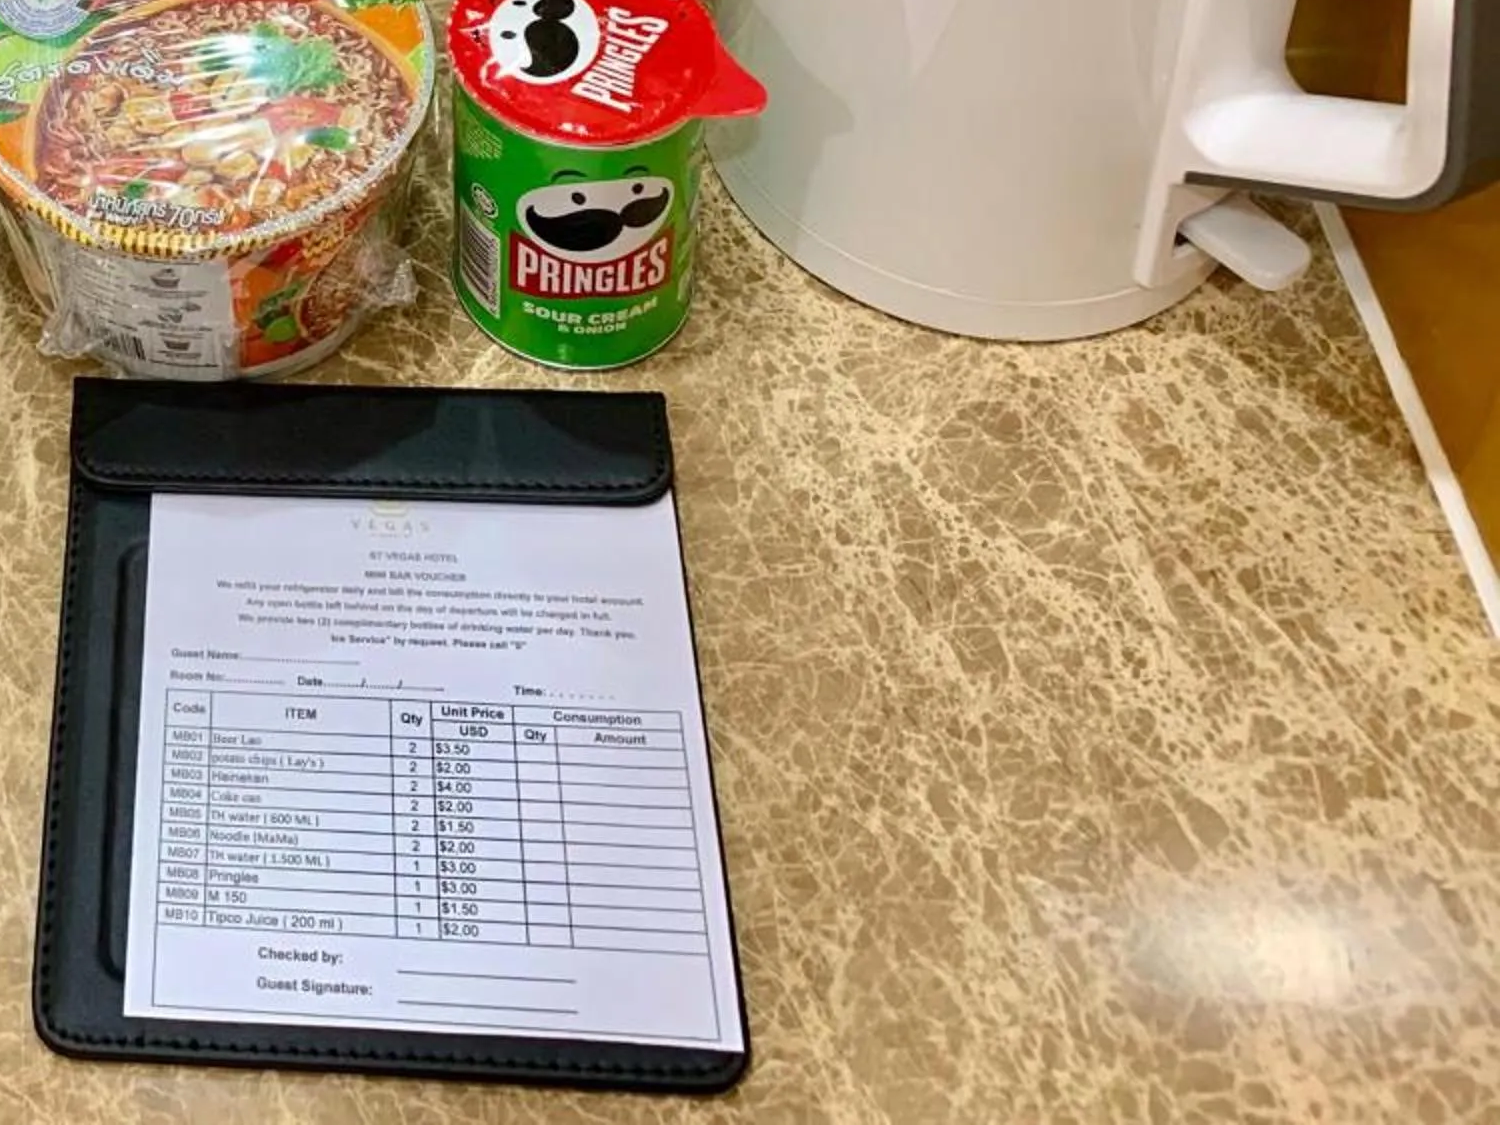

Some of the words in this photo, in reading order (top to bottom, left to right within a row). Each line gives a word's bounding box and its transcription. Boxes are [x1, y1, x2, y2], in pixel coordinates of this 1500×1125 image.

[571, 6, 671, 114] PRINGLES
[516, 236, 669, 295] PRINGLES
[521, 300, 583, 325] SOUR
[587, 296, 659, 325] CREAM
[513, 684, 546, 696] Time:
[173, 701, 206, 714] Code
[285, 706, 317, 720] ITEM
[400, 712, 423, 727] Qty
[441, 705, 468, 719] Unit
[470, 706, 506, 721] Price
[552, 710, 643, 726] Consumption
[459, 725, 489, 739] USD
[524, 728, 547, 743] Qty
[594, 732, 647, 746] Amount
[435, 741, 471, 755] $3.50
[435, 761, 471, 775] $2.00
[436, 781, 472, 794] $4.00
[437, 801, 473, 814] $2.00
[228, 811, 262, 824] water
[438, 821, 474, 835] $1.50
[439, 840, 475, 854] $2.00
[167, 846, 200, 859] MB07
[227, 850, 260, 864] water
[440, 860, 477, 875] $3.00
[209, 868, 260, 885] Pringles
[441, 881, 477, 895] $3.00
[208, 889, 220, 903] M
[225, 890, 247, 904] 150
[442, 901, 479, 916] $1.50
[165, 907, 198, 921] MB10
[208, 909, 243, 927] Tipco
[246, 911, 279, 927] Juice
[291, 913, 316, 928] 200
[443, 923, 480, 938] $2.00
[257, 946, 318, 962] Checked
[321, 949, 344, 967] by:
[257, 976, 297, 991] Guest
[301, 977, 373, 997] Signature:
